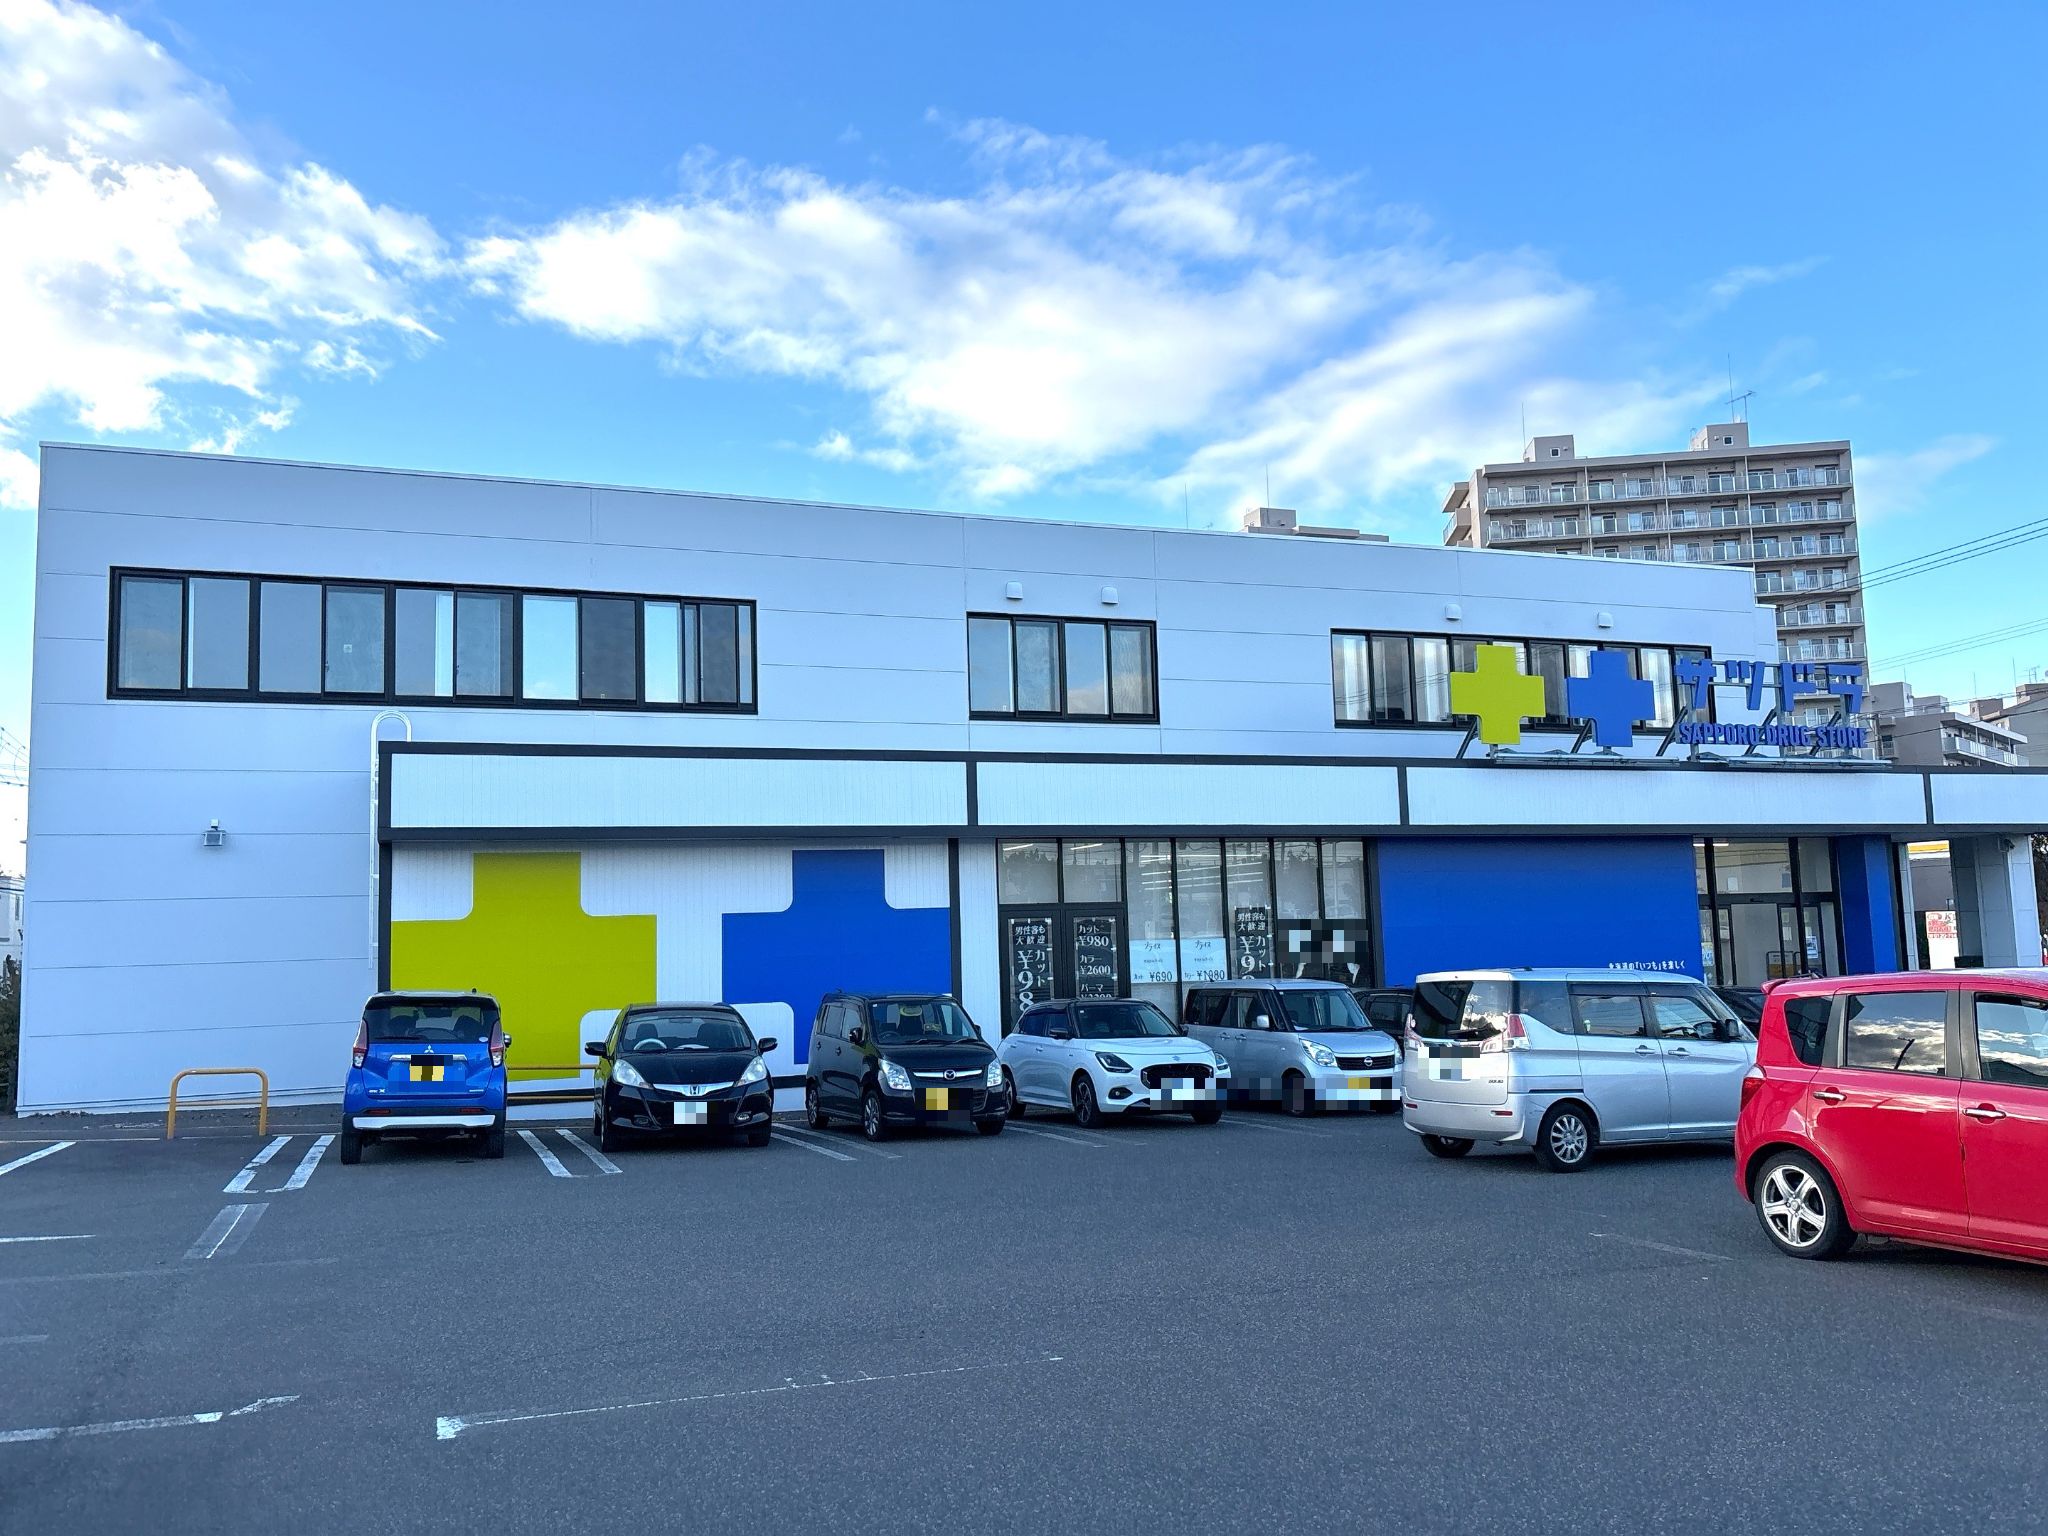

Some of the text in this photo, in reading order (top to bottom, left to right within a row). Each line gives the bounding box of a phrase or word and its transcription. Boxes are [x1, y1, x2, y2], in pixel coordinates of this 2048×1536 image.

[1675, 658, 1863, 713] サツドラ
[1679, 723, 1867, 748] SAPPORO DRUG STORE
[1015, 925, 1046, 935] 男性客も
[1079, 925, 1100, 933] カット
[1079, 935, 1109, 946] ¥980
[1079, 954, 1102, 964] カラー
[1240, 935, 1256, 980] ¥9
[1256, 935, 1267, 971] カット
[1035, 949, 1046, 987] カット
[1080, 965, 1111, 975] ¥2600
[1149, 970, 1173, 982] ¥690
